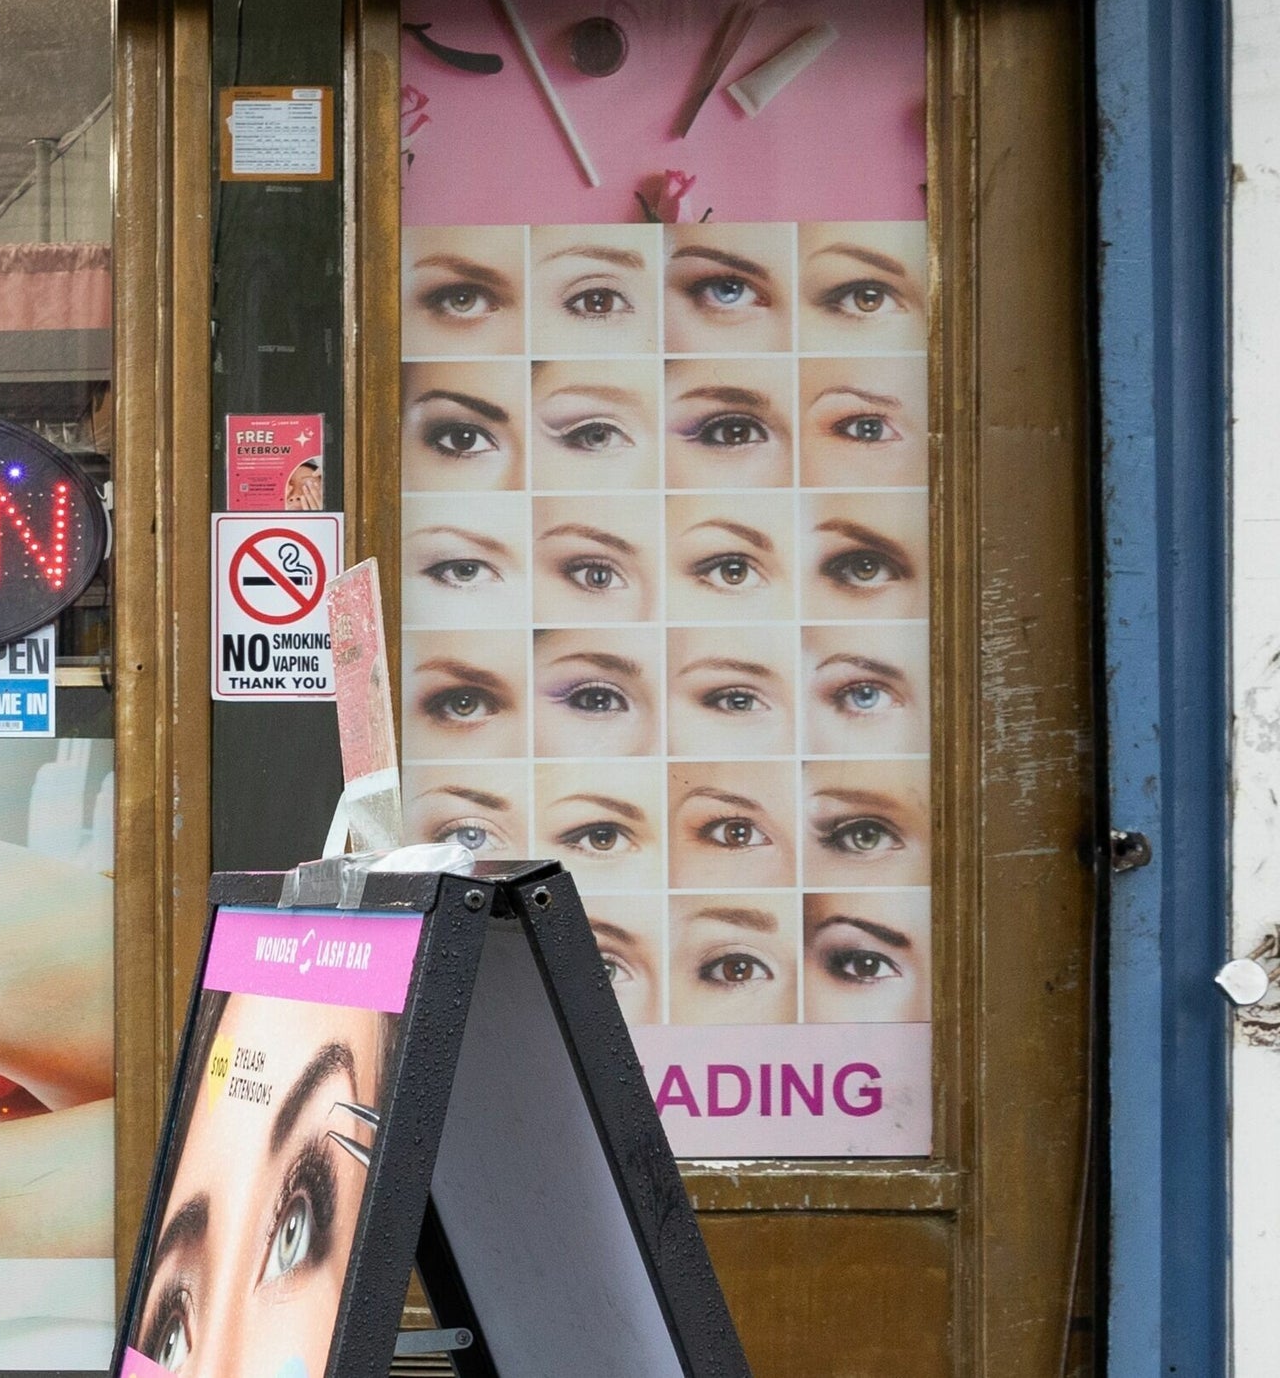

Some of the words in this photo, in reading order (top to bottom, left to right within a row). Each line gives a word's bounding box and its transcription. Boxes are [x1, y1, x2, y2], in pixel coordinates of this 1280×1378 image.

[236, 430, 274, 444] FREE
[237, 446, 291, 455] EYEBROW
[223, 633, 270, 672] NO
[273, 633, 331, 650] SMOKING
[273, 655, 319, 672] VAPING
[229, 677, 286, 689] THANK
[292, 677, 327, 689] YOU
[26, 692, 48, 715] IN
[255, 935, 298, 964] WONDER
[315, 940, 345, 967] LASH
[346, 941, 372, 971] BAR
[234, 1047, 267, 1073] EYELASH
[228, 1076, 273, 1106] EXTENSIONS
[647, 1062, 883, 1118] ADING
